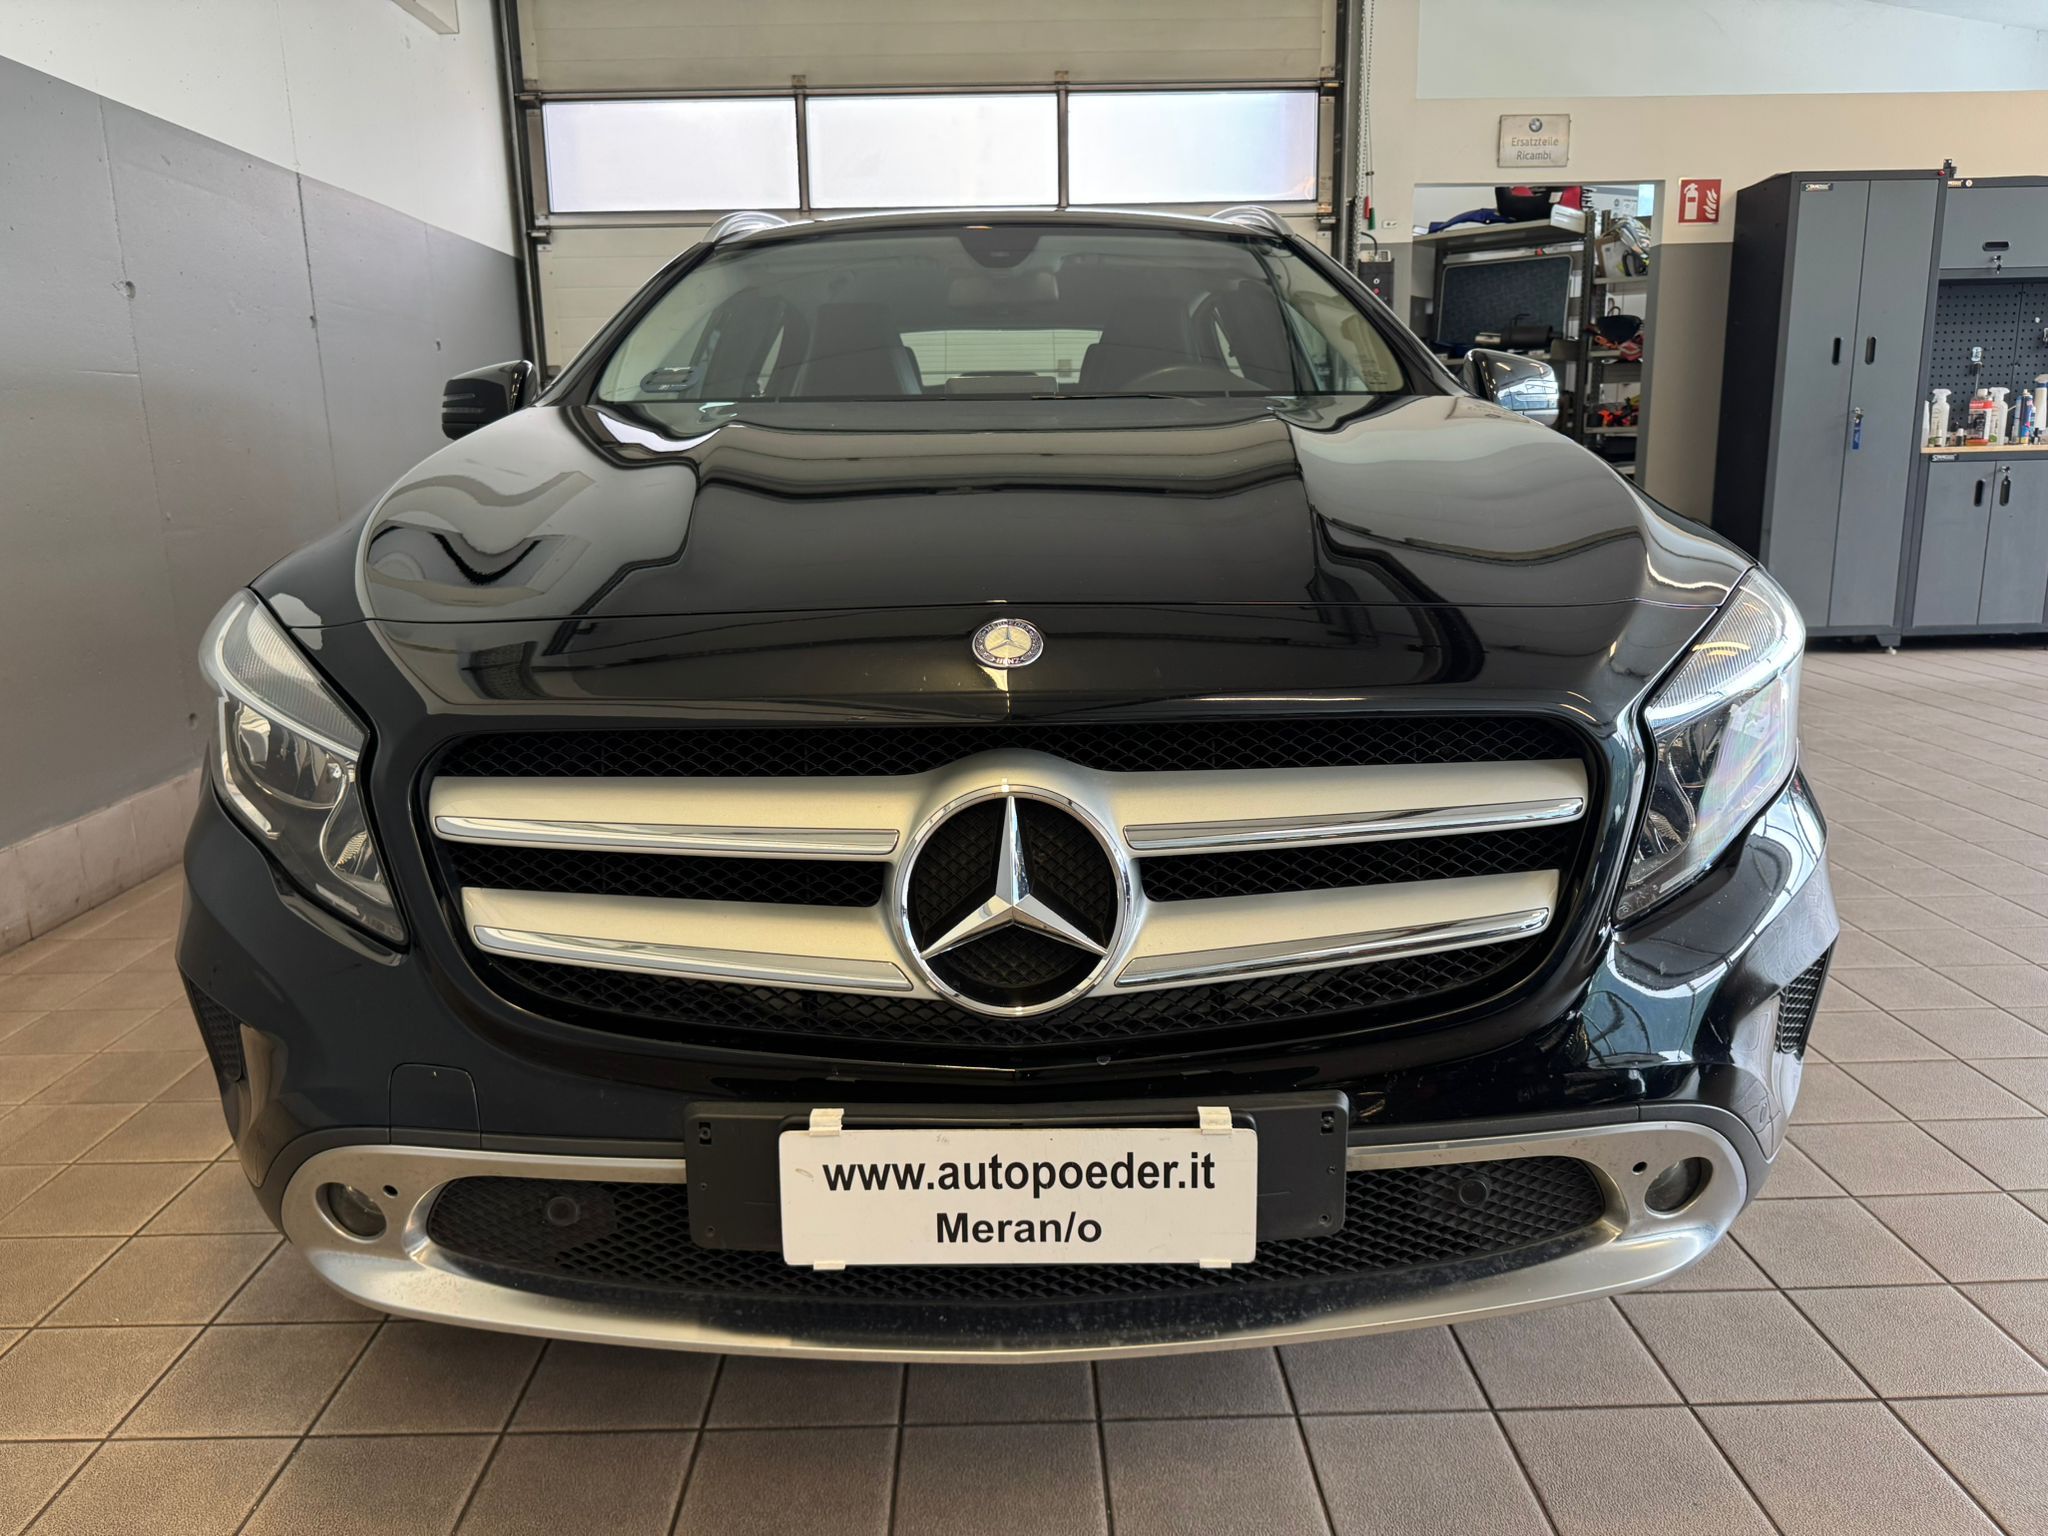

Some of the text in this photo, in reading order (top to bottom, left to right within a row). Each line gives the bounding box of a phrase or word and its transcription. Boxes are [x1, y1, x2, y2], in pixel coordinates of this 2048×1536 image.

[1511, 136, 1559, 147] Ersatzteile
[1516, 150, 1552, 160] Ricambi
[822, 1152, 1215, 1199] www.autopoeder.it
[936, 1211, 1103, 1244] Meran/o
